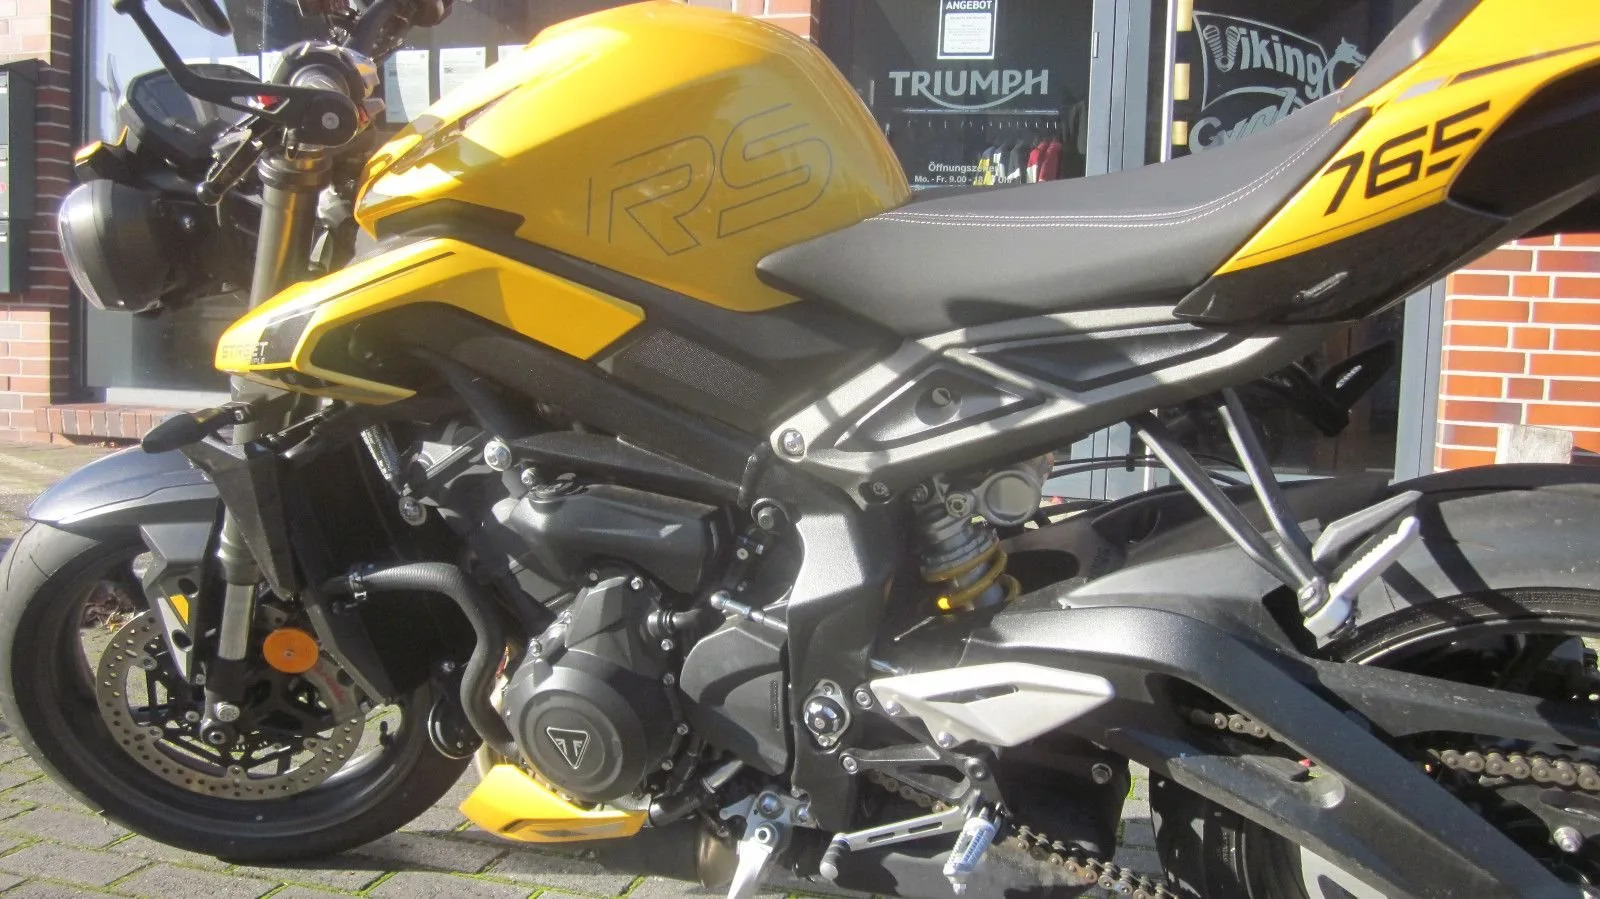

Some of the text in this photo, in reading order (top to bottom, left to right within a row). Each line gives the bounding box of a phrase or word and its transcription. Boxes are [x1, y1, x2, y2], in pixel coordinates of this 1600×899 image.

[945, 1, 993, 10] ANGEBOT
[888, 69, 1049, 108] TRIUMPH
[1203, 24, 1325, 100] Viking
[586, 103, 833, 256] RS
[1322, 100, 1491, 216] 765
